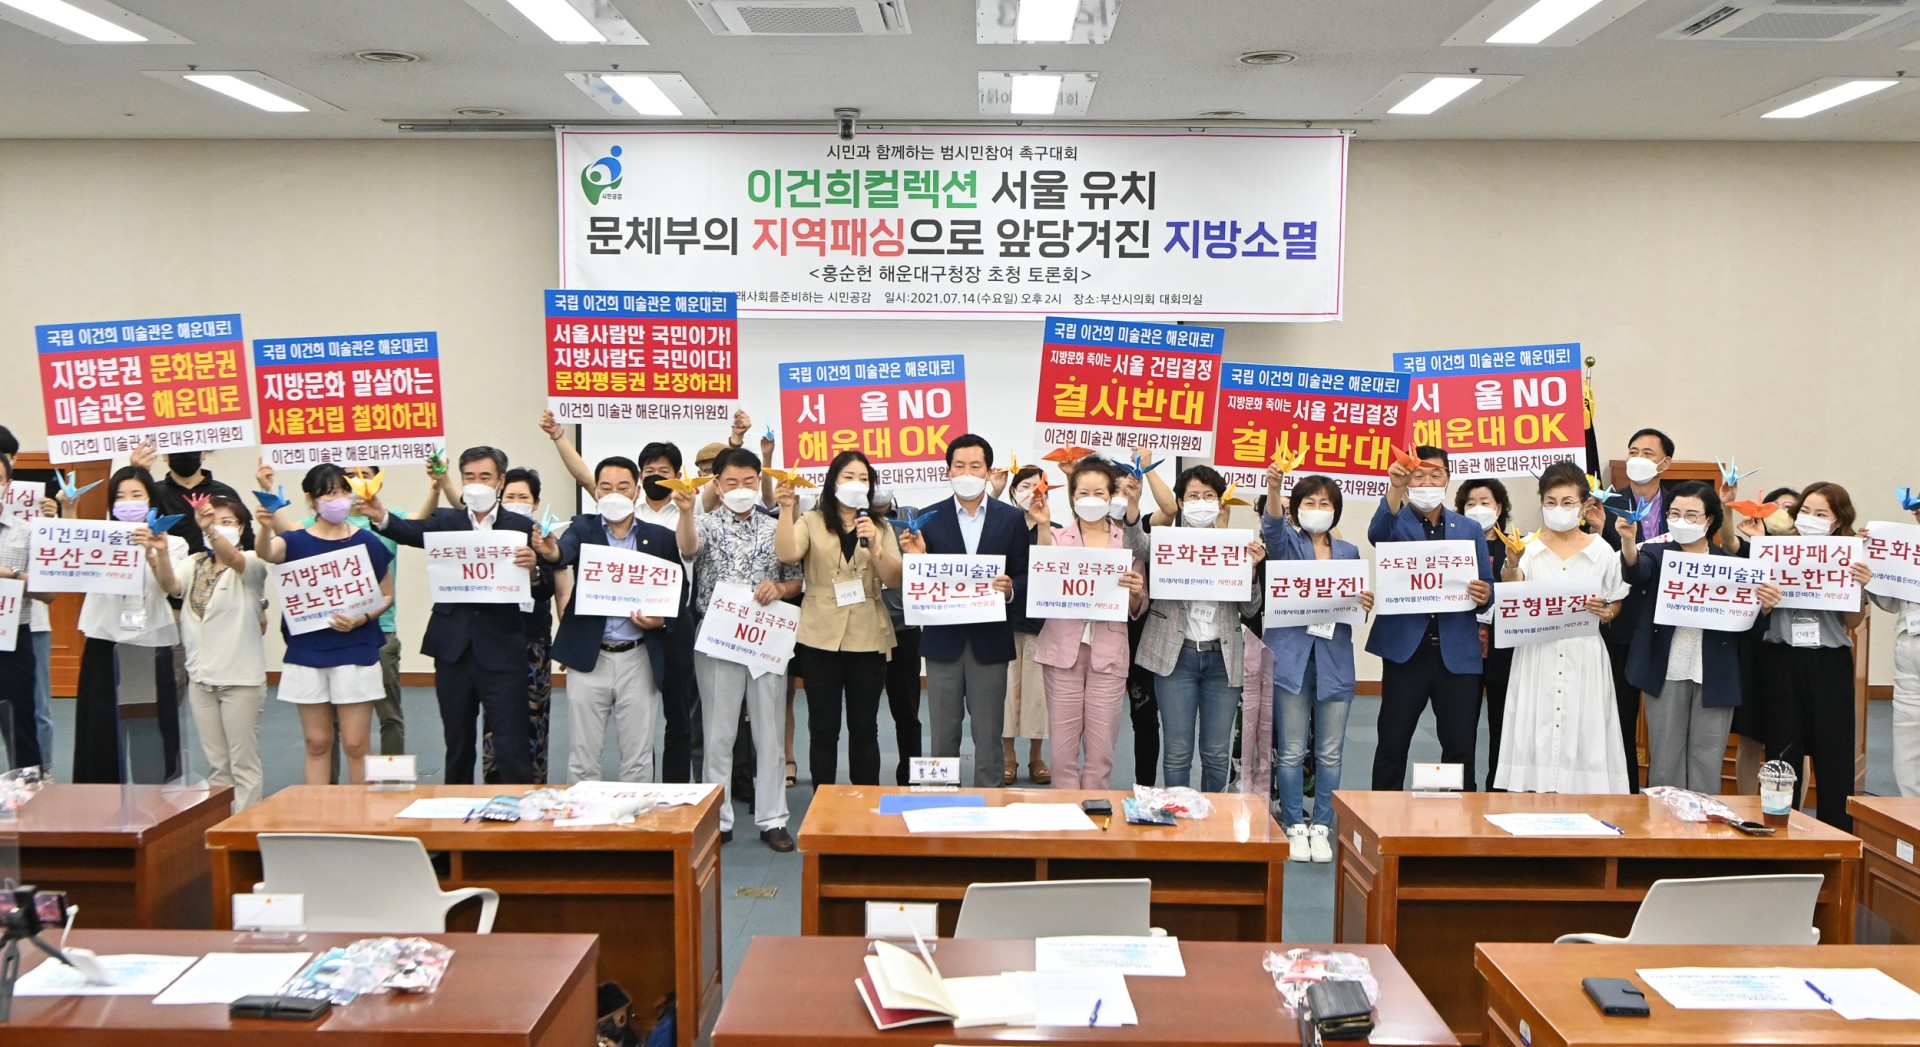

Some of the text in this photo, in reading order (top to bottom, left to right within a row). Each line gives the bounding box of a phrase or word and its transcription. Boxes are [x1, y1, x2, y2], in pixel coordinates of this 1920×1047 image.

[826, 145, 1078, 161] 시민과 함께하는 범시민참여 촉구대회
[747, 169, 1156, 210] 이건희컬렉션 서울 유치
[586, 216, 1318, 260] 문체부의 지역패싱으로 앞당겨진 지방소멸
[808, 264, 1092, 284] <홍순헌 해운대구청장 초청 토론회>
[555, 295, 726, 313] 국립 이건희 미술관은 해운대로!
[733, 291, 823, 303] 래사회를준비하는
[827, 291, 872, 303] 시민공감
[1159, 294, 1203, 306] 대회의실
[48, 321, 232, 347] 국립 이건희 미술관은 해운대로!
[553, 324, 731, 346] 서울사람만 국민이가!
[1055, 323, 1214, 348] 국립 이건희 미술관은 해운대로!
[263, 338, 428, 360] 국립 이건희 미술관은 해운대로!
[554, 348, 731, 370] 지방사람도 국민이다!
[51, 350, 237, 390] 지방분권 문화분권
[789, 360, 955, 383] 국립 이건희 미술관은 해운대로!
[1050, 350, 1212, 381] 지방문화 죽이는 서울 건립결정
[1404, 349, 1570, 372] 국립 이건희 미술관은 해운대로!
[264, 368, 434, 401] 지방문화 말살하는
[555, 371, 731, 393] 문화평등권 보장하라!
[1231, 369, 1399, 394] 국립 이건희 미술관은 해운대로!
[1513, 376, 1567, 409] NO
[55, 386, 241, 426] 미술관은 해운대로
[560, 403, 728, 420] 이건희 미술관 해운대유치위원회
[898, 388, 952, 420] NO
[1053, 380, 1205, 424] 결사반대
[1228, 395, 1398, 427] 지방문화 죽이는 서울 건립결정
[266, 402, 438, 436] 서울건립 철회하라!
[1045, 429, 1202, 451] 이건희 미술관 해운대유치위원회
[1413, 413, 1569, 449] 해운대 OK
[62, 439, 98, 456] 이건희
[104, 436, 140, 453] 미술관
[272, 443, 436, 464] 이건희 미술관 해운대유치위원회
[798, 424, 951, 462] 해운대 OK
[1448, 458, 1480, 474] 미술관
[1224, 472, 1256, 488] 이건희
[39, 527, 140, 546] 이건희미술관
[36, 548, 139, 568] 부산으로!
[429, 547, 467, 559] 수도권
[1155, 544, 1248, 566] 문화분권!
[1380, 556, 1474, 570] 수도권 일극주의
[1759, 545, 1852, 567] 지방패싱
[281, 555, 362, 587] 지방패싱
[462, 563, 495, 579] NO!
[584, 561, 676, 586] 균형발전!
[909, 563, 1000, 579] 이건희미술관
[1032, 561, 1128, 576] 수도권 일극주의
[1669, 561, 1765, 585] 이건희미술관
[1062, 579, 1095, 596] NO!
[1270, 577, 1364, 598] 균형발전!
[1410, 573, 1443, 590] NO!
[286, 577, 374, 616] 분노한다!
[1500, 594, 1596, 618] 균형발전
[713, 598, 798, 632] 수도권 일극주의
[734, 623, 767, 646] NO!
